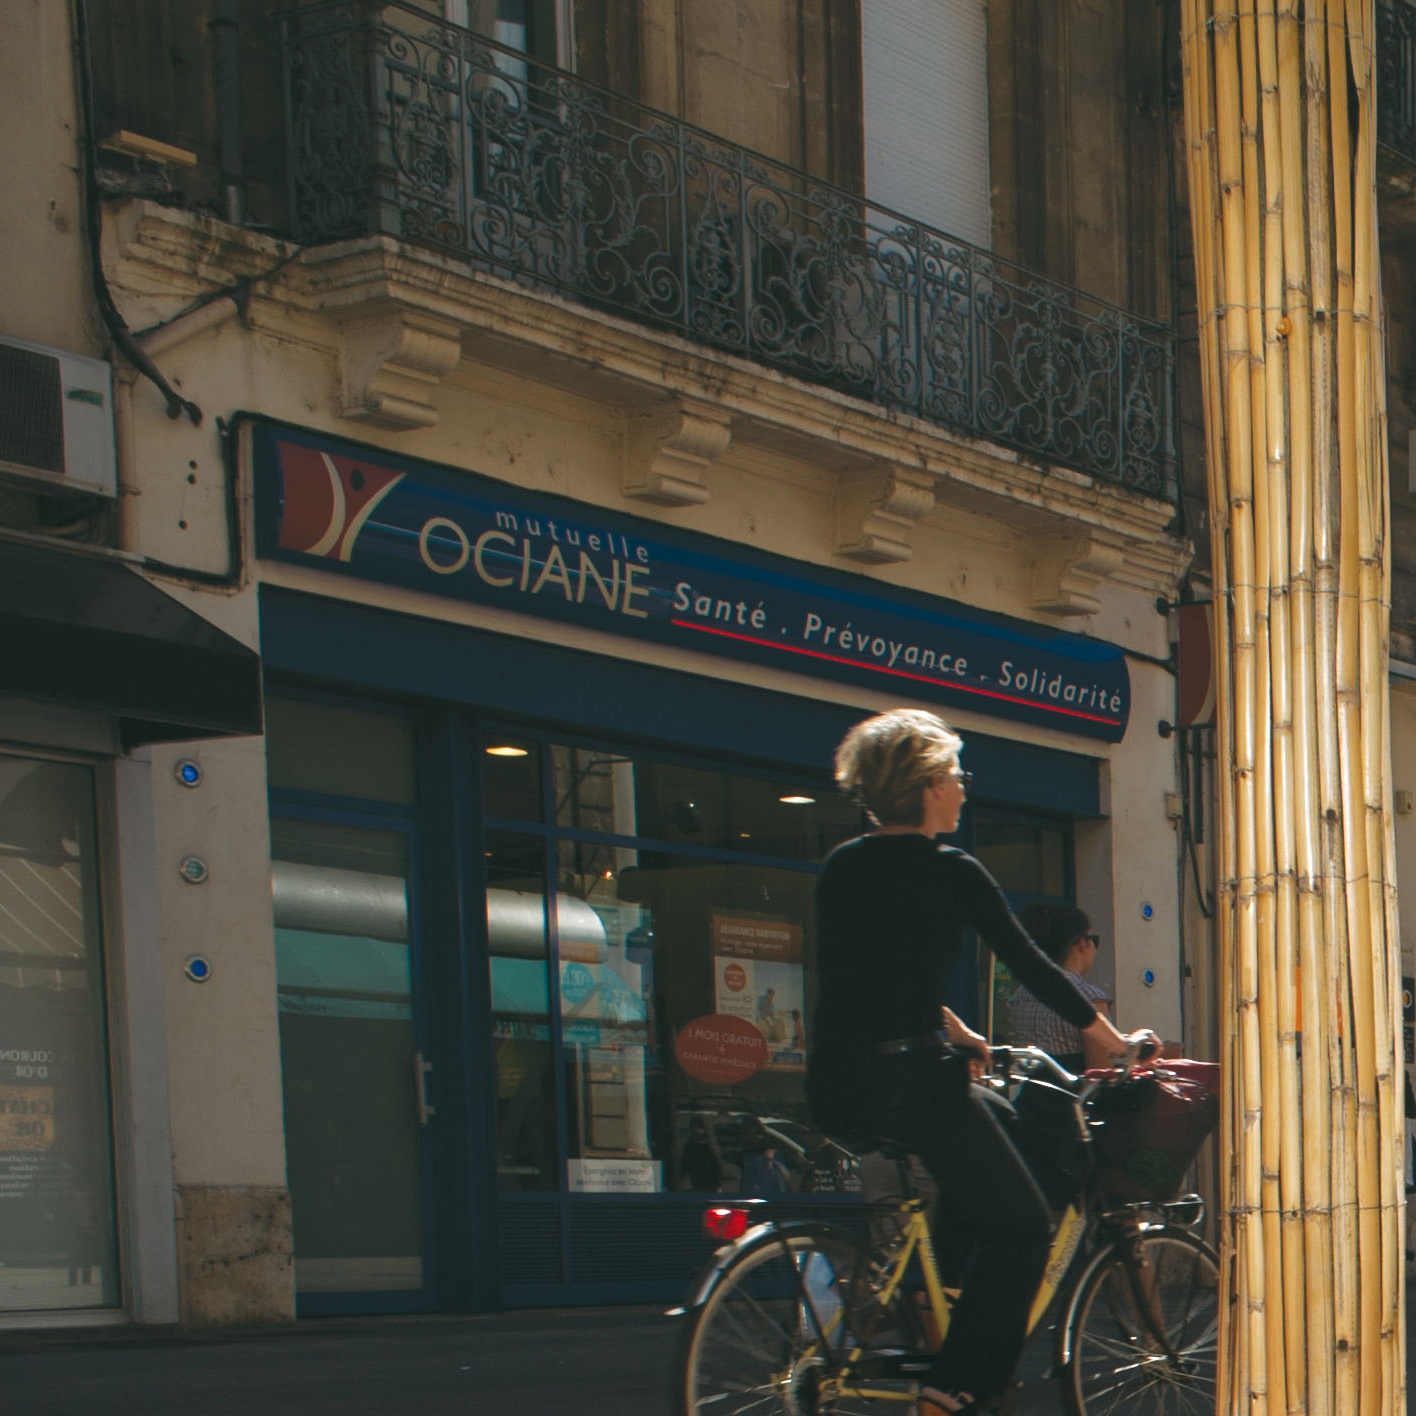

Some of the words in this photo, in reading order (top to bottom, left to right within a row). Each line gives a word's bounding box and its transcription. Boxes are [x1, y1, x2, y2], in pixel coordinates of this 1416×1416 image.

[418, 516, 652, 619] OCIANE
[496, 511, 651, 564] mutuelle
[673, 581, 768, 629] Santé
[803, 612, 968, 678] Prévoyance
[998, 660, 1123, 714] Solidarité
